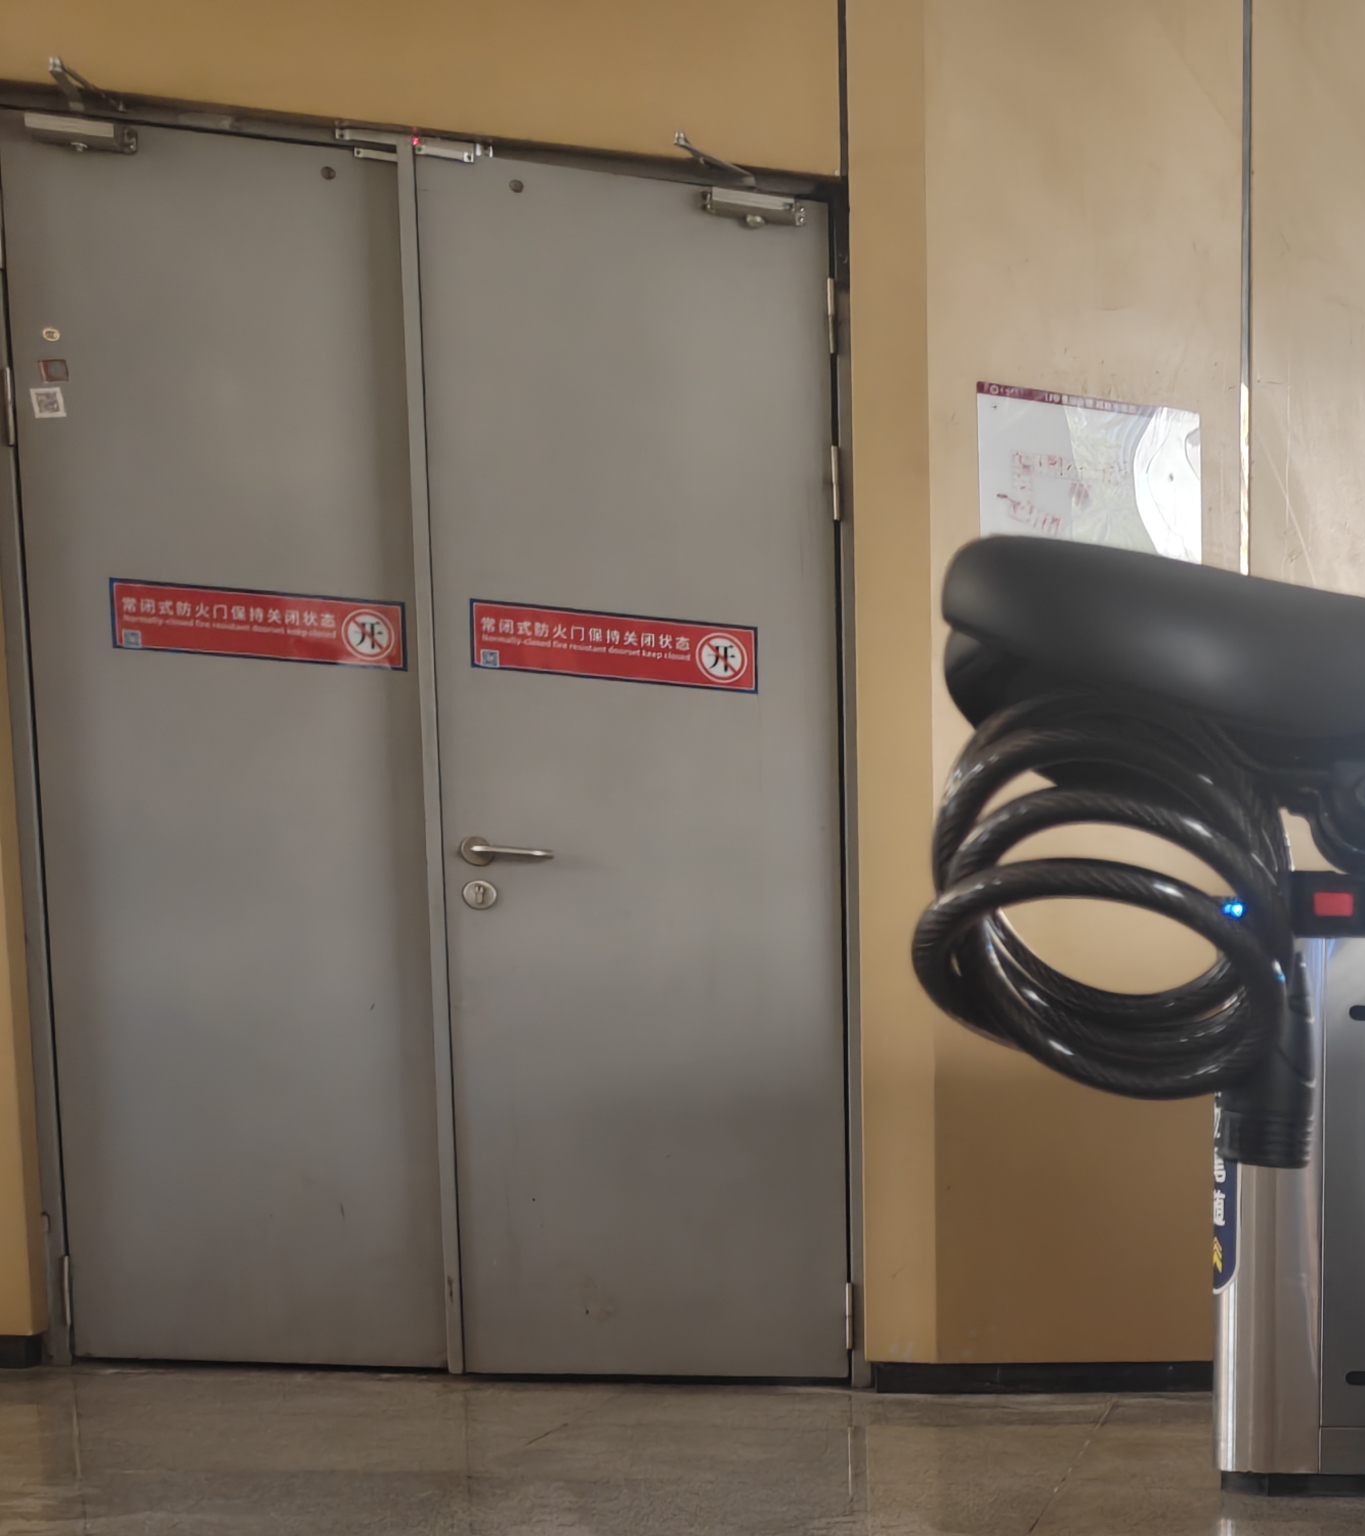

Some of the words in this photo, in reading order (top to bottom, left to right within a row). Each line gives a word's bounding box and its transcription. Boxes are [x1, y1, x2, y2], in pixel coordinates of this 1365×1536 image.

[122, 597, 337, 628] 常闭式防火门保持关闭状态
[480, 617, 691, 651] 常闭式防火门保持关闭状态
